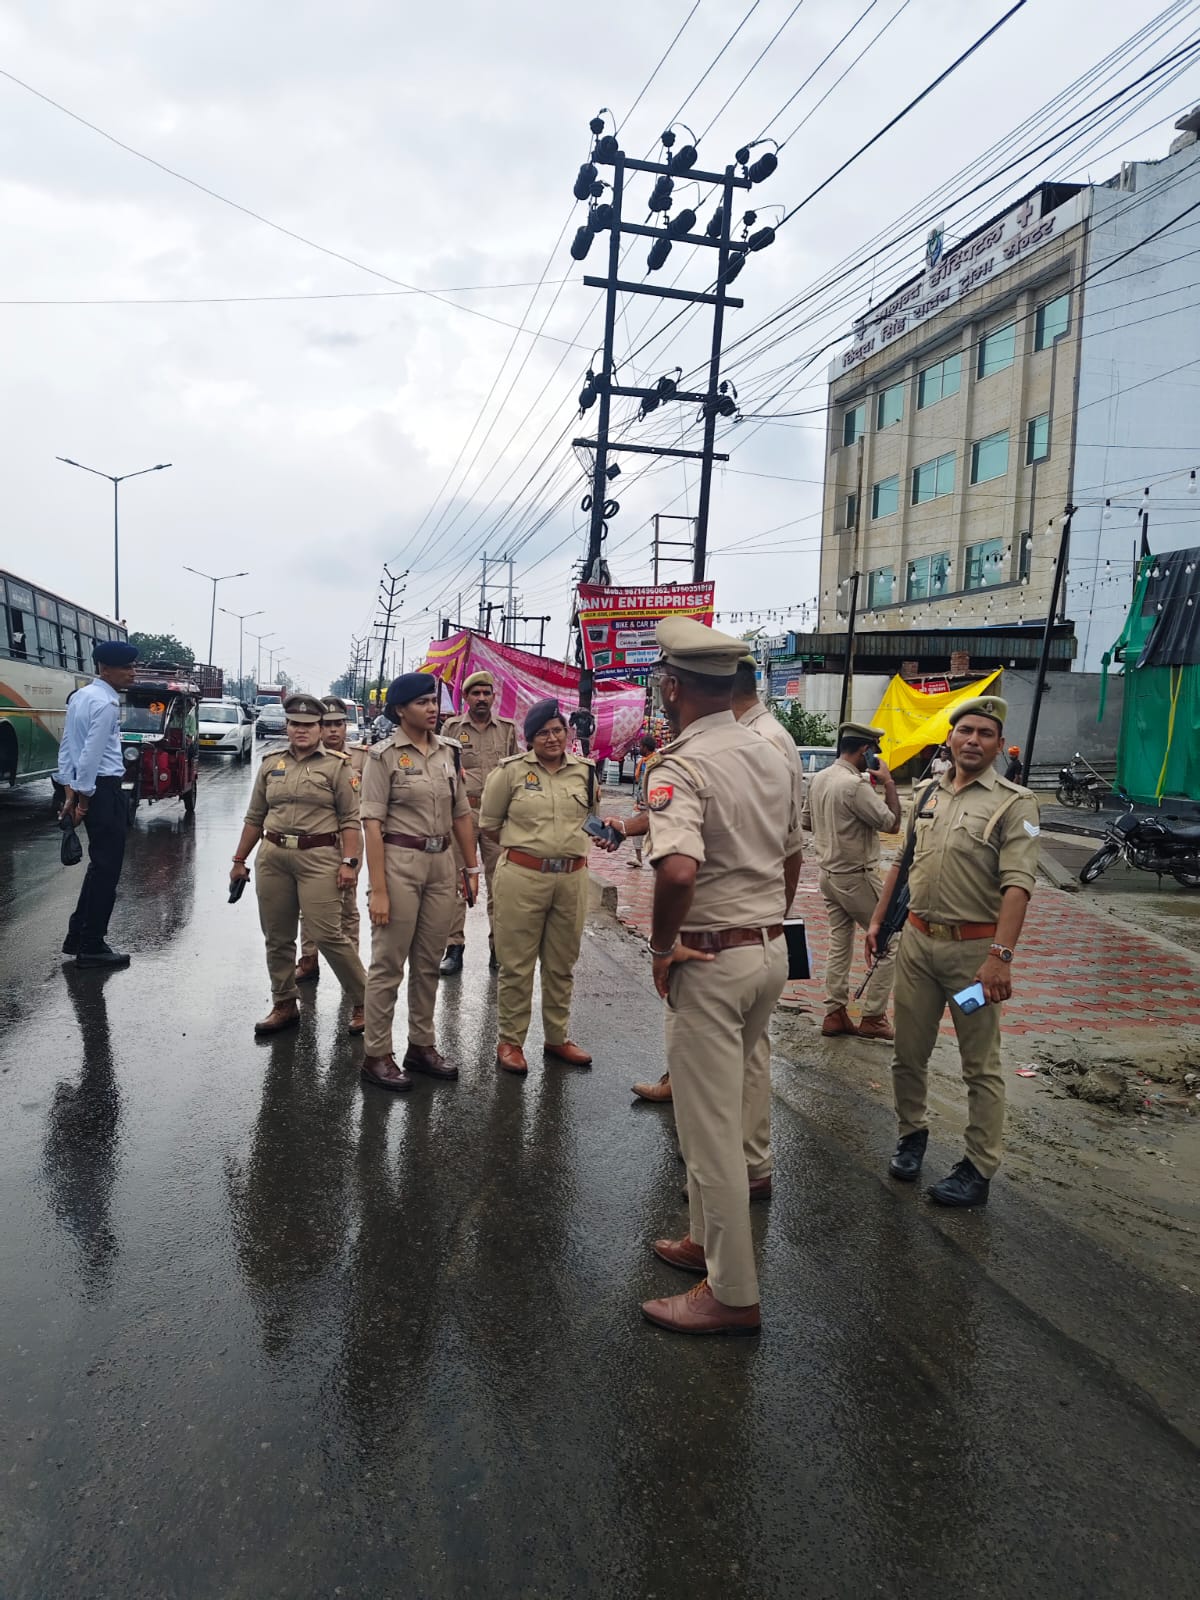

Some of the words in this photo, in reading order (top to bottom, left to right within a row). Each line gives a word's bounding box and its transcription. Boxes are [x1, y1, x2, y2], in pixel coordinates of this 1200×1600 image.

[618, 593, 711, 608] ENTERPRISES
[615, 621, 629, 629] BIKE
[636, 620, 649, 628] CAR
